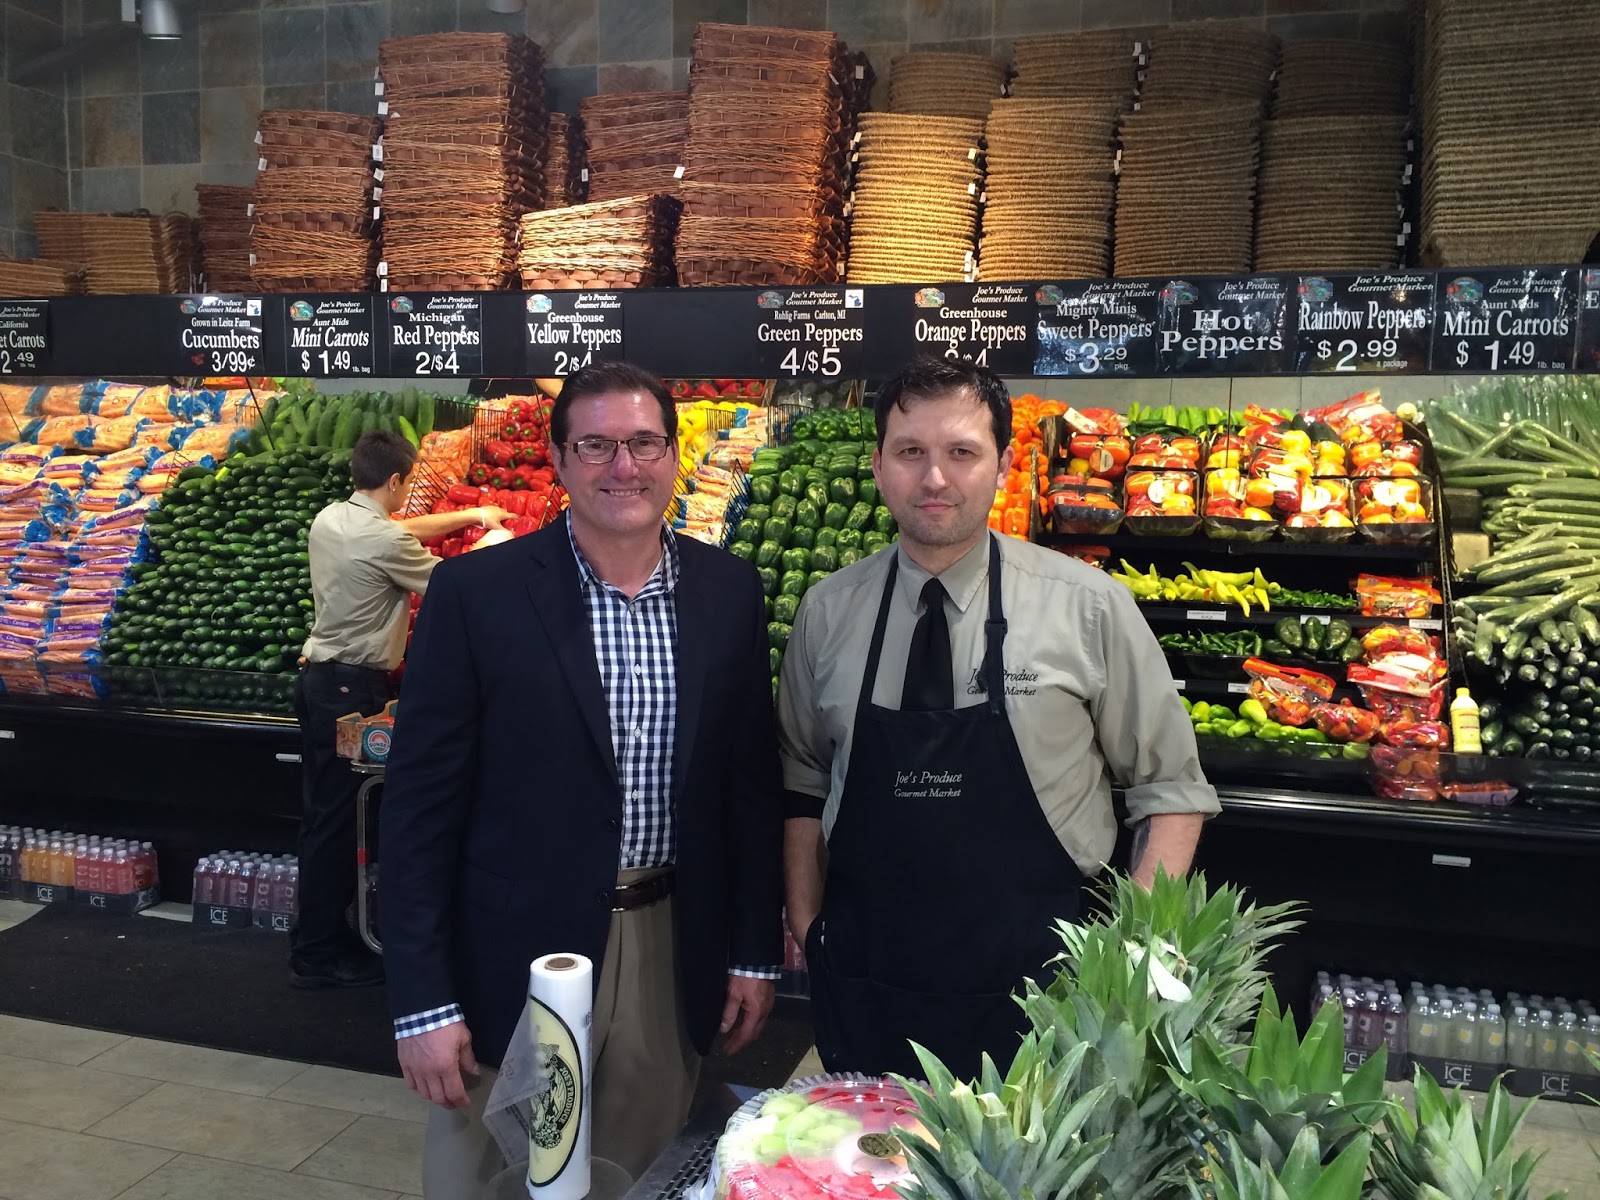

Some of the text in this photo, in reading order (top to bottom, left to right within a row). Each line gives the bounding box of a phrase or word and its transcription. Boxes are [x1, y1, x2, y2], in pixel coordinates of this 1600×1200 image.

[1353, 275, 1425, 285] Joe's Produce
[1495, 278, 1520, 287] Joe's
[976, 286, 1024, 296] Joe's Produce
[1088, 282, 1150, 292] Joe's Produce
[1223, 281, 1280, 292] Joe's Produce
[1347, 282, 1434, 292] Gourmet Market
[1488, 286, 1531, 294] Gourmet
[577, 293, 618, 301] Joe's Produce
[789, 291, 808, 300] Joe's
[971, 294, 1028, 303] Gourmet Market
[1121, 289, 1156, 298] Market
[1255, 290, 1285, 300] Market
[217, 299, 243, 307] Produce
[318, 301, 333, 309] Joe's
[430, 296, 446, 304] Joe's
[574, 301, 621, 309] Gourmet Market
[816, 298, 843, 306] Market
[1480, 300, 1508, 310] Aunt
[197, 306, 247, 314] Gourmet Market
[837, 309, 847, 320] MI
[939, 306, 1008, 320] Greenhouse
[1055, 302, 1138, 319] Mighty Minis
[191, 317, 211, 327] Grown
[212, 317, 218, 327] in
[312, 318, 350, 327] Aunt Mids
[409, 313, 466, 324] Michigan
[547, 312, 605, 323] Greenhouse
[1191, 309, 1254, 331] Hot
[1299, 300, 1426, 340] Rainbow Peppers
[1442, 310, 1569, 336] Mini Carrots
[291, 326, 370, 348] Mini Carrots
[527, 323, 622, 351] Yellow Peppers
[757, 322, 864, 348] Green Peppers
[914, 318, 1027, 350] Orange Peppers
[1037, 318, 1152, 346] Sweet Peppers
[9, 329, 46, 348] Carrots
[182, 329, 260, 349] Cucumbers
[393, 324, 481, 352] Red Peppers
[1160, 330, 1284, 359] Peppers
[1382, 360, 1408, 369] package
[1005, 686, 1037, 696] Market
[894, 770, 963, 788] Joe's Produce
[894, 788, 962, 798] Gourmet Market
[89, 895, 106, 908] ICE
[210, 908, 229, 922] ICE
[271, 915, 290, 929] ICE
[1444, 1065, 1473, 1082] ICE
[1541, 1075, 1571, 1093] ICE
[559, 1066, 574, 1124] JOE'S PRODUCE
